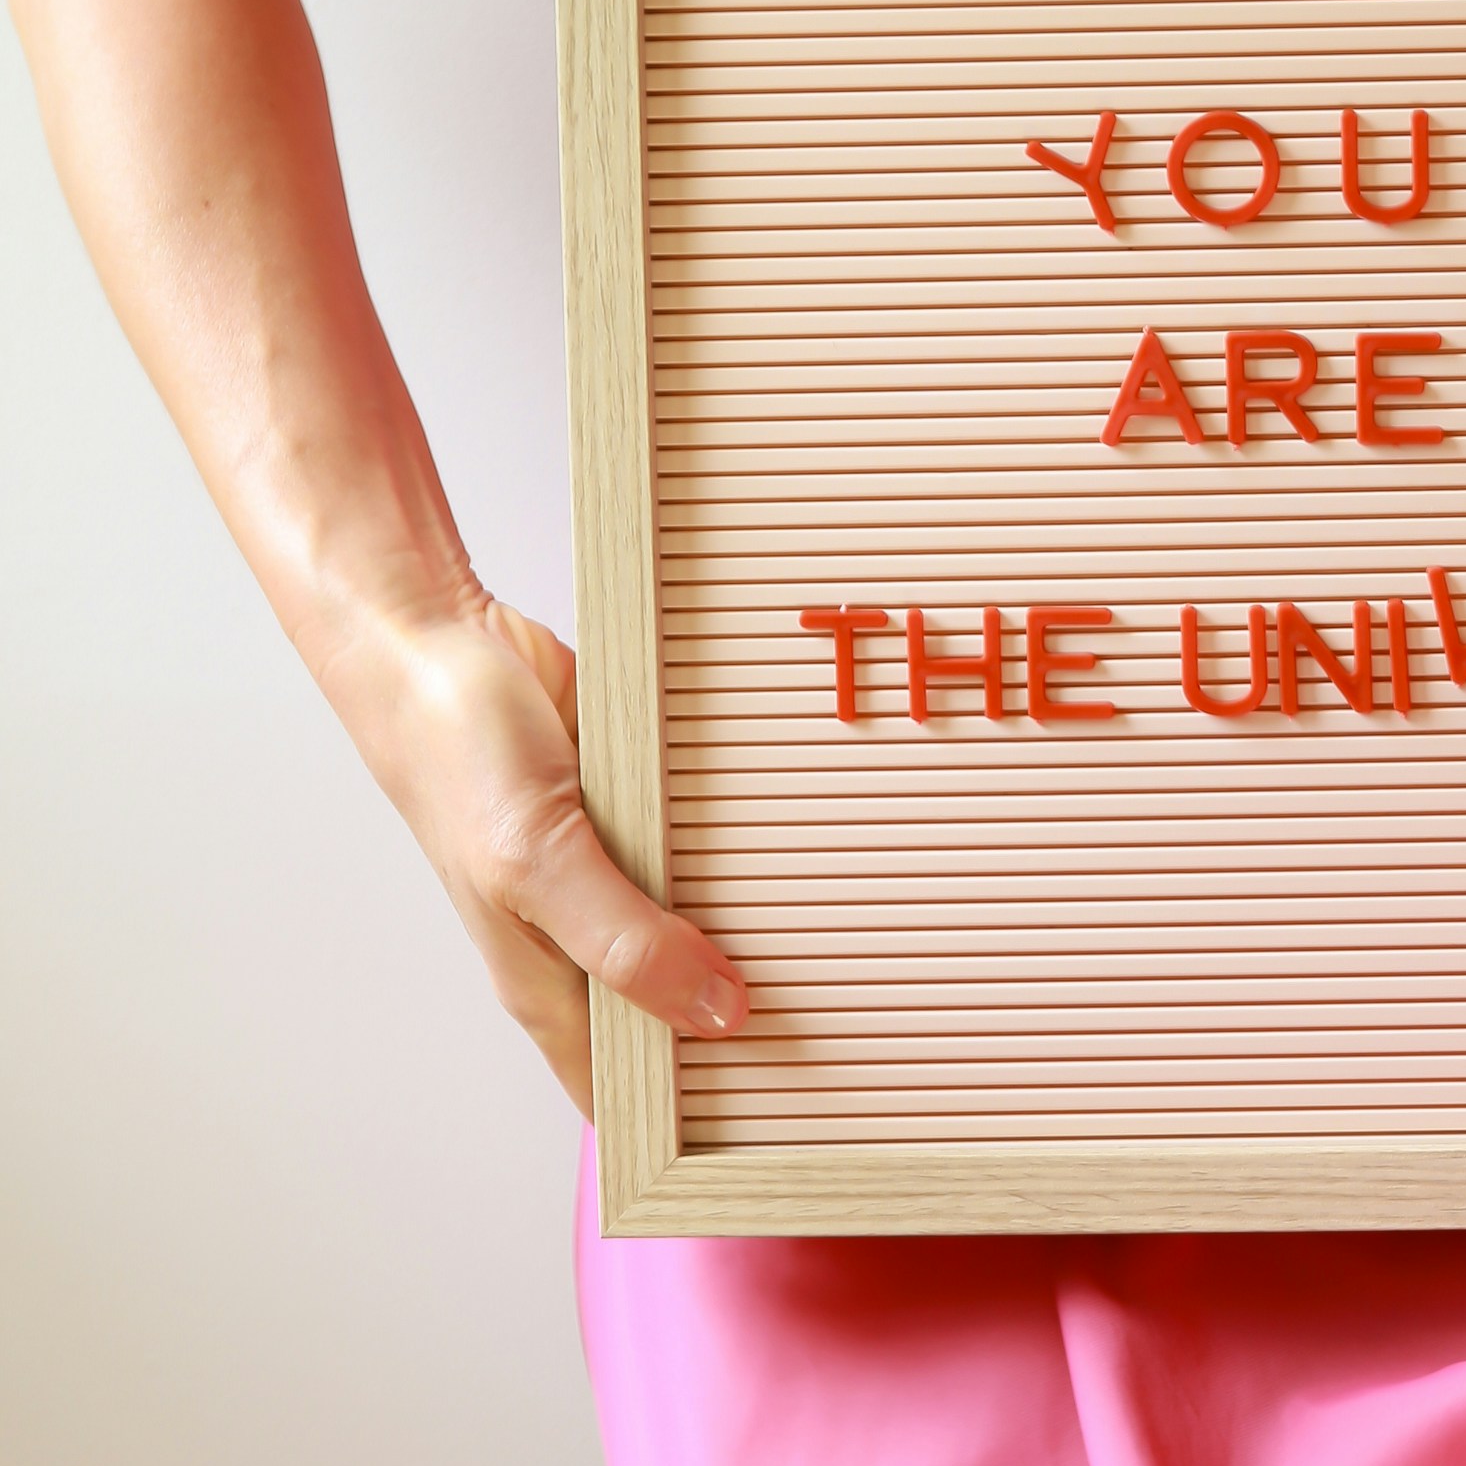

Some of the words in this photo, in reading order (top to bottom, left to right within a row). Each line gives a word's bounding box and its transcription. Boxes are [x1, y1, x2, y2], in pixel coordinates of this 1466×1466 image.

[1025, 108, 1433, 234] YOU
[1101, 326, 1447, 449] ARE
[798, 603, 1119, 724] THE
